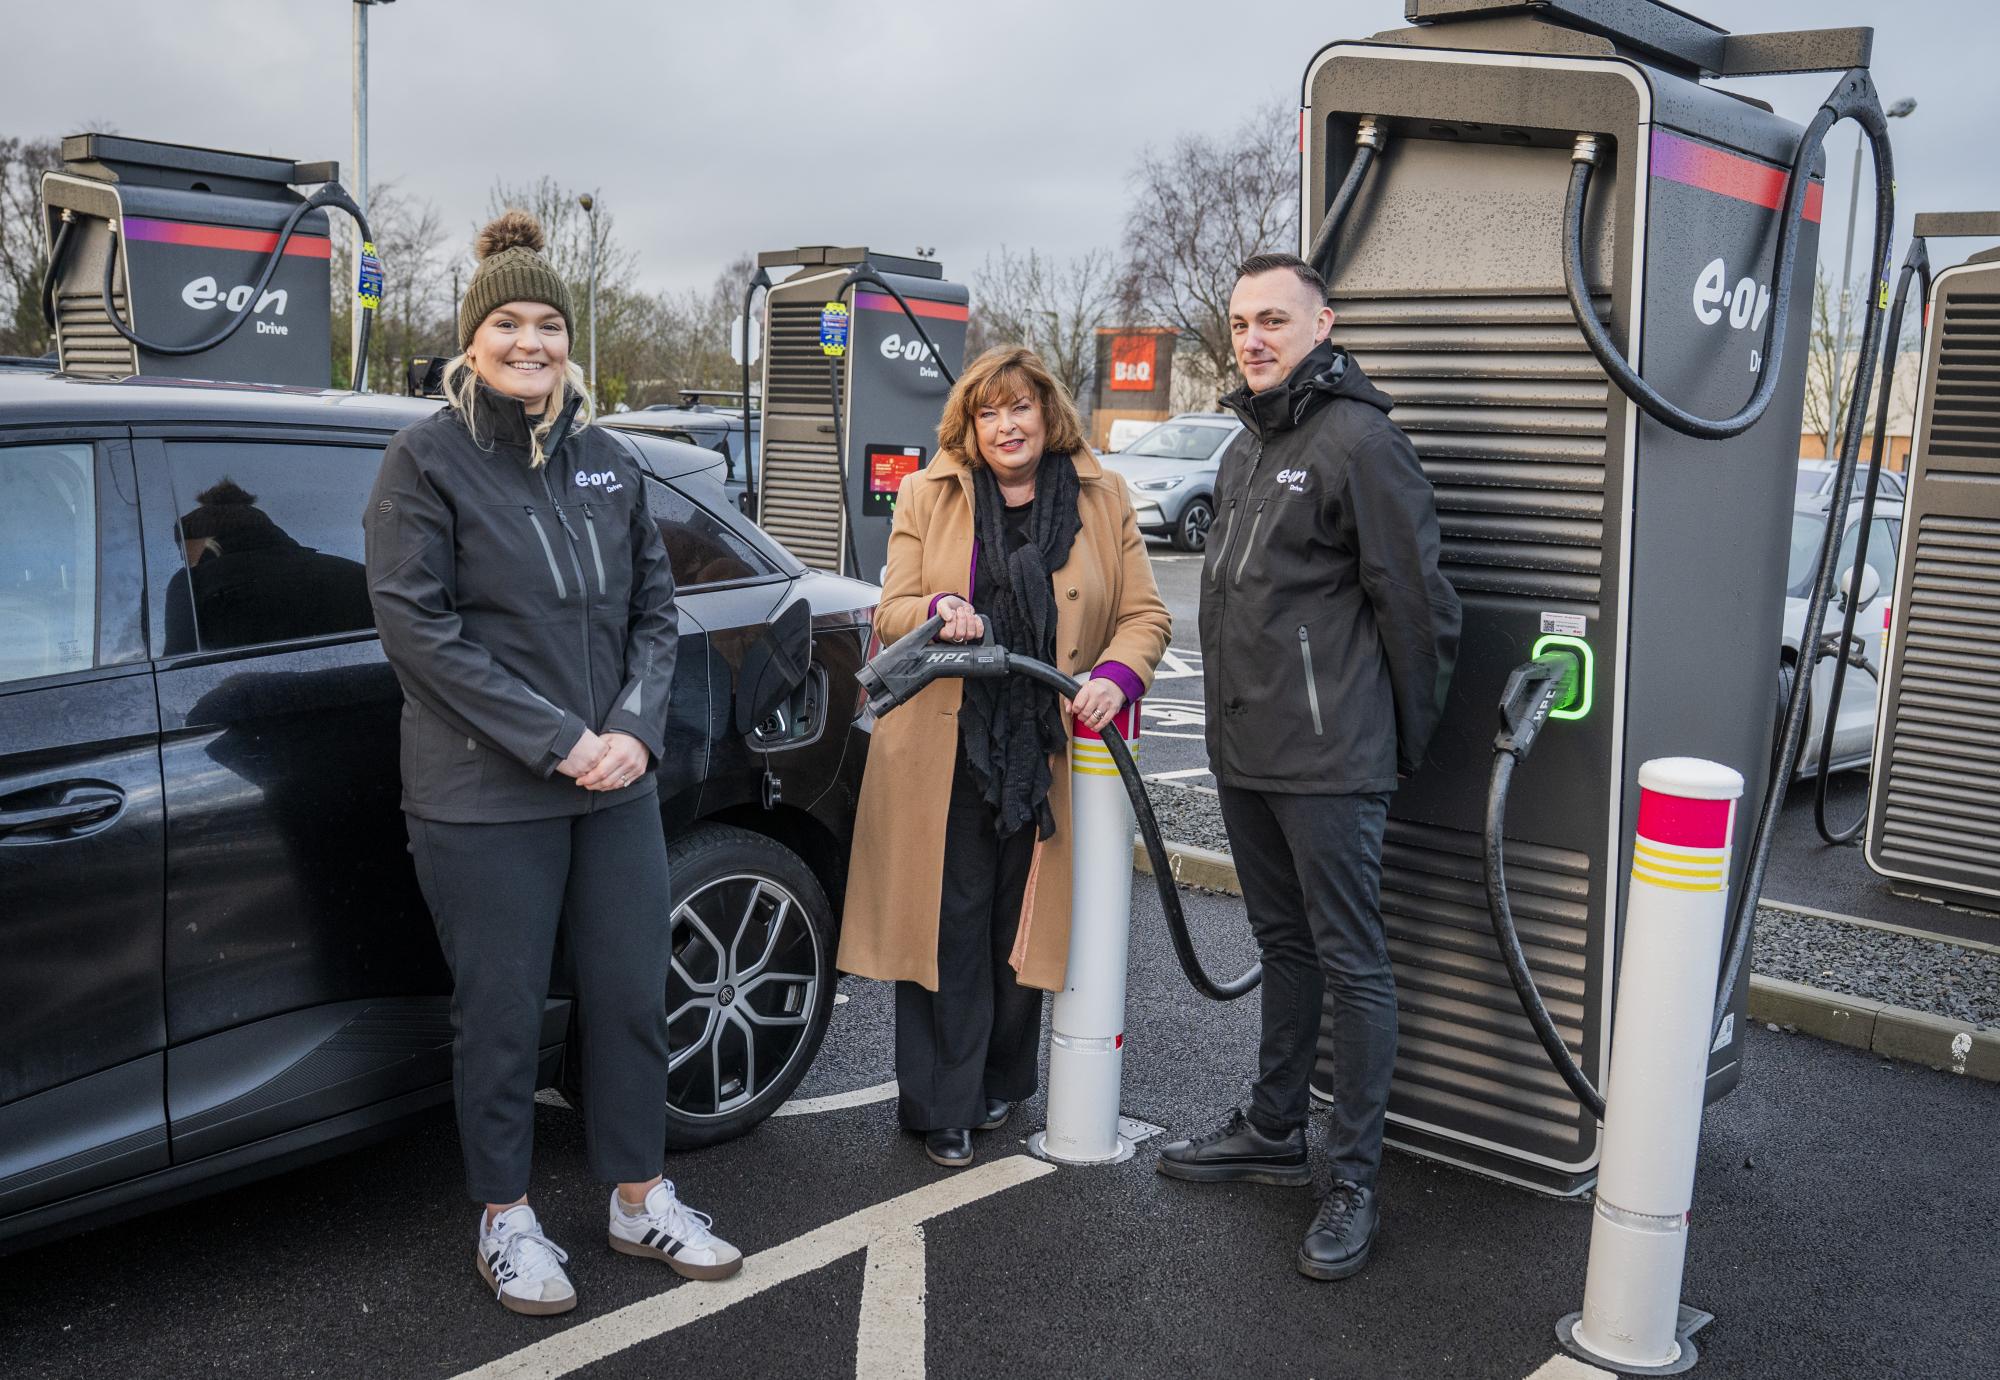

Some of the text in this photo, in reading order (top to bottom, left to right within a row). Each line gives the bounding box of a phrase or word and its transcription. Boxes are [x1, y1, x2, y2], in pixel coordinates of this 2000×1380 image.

[256, 320, 289, 336] Drive
[920, 366, 939, 378] Drive
[1115, 361, 1150, 381] B&Q
[606, 483, 623, 493] Drive
[926, 652, 970, 663] HPC
[1532, 689, 1556, 720] HPC
